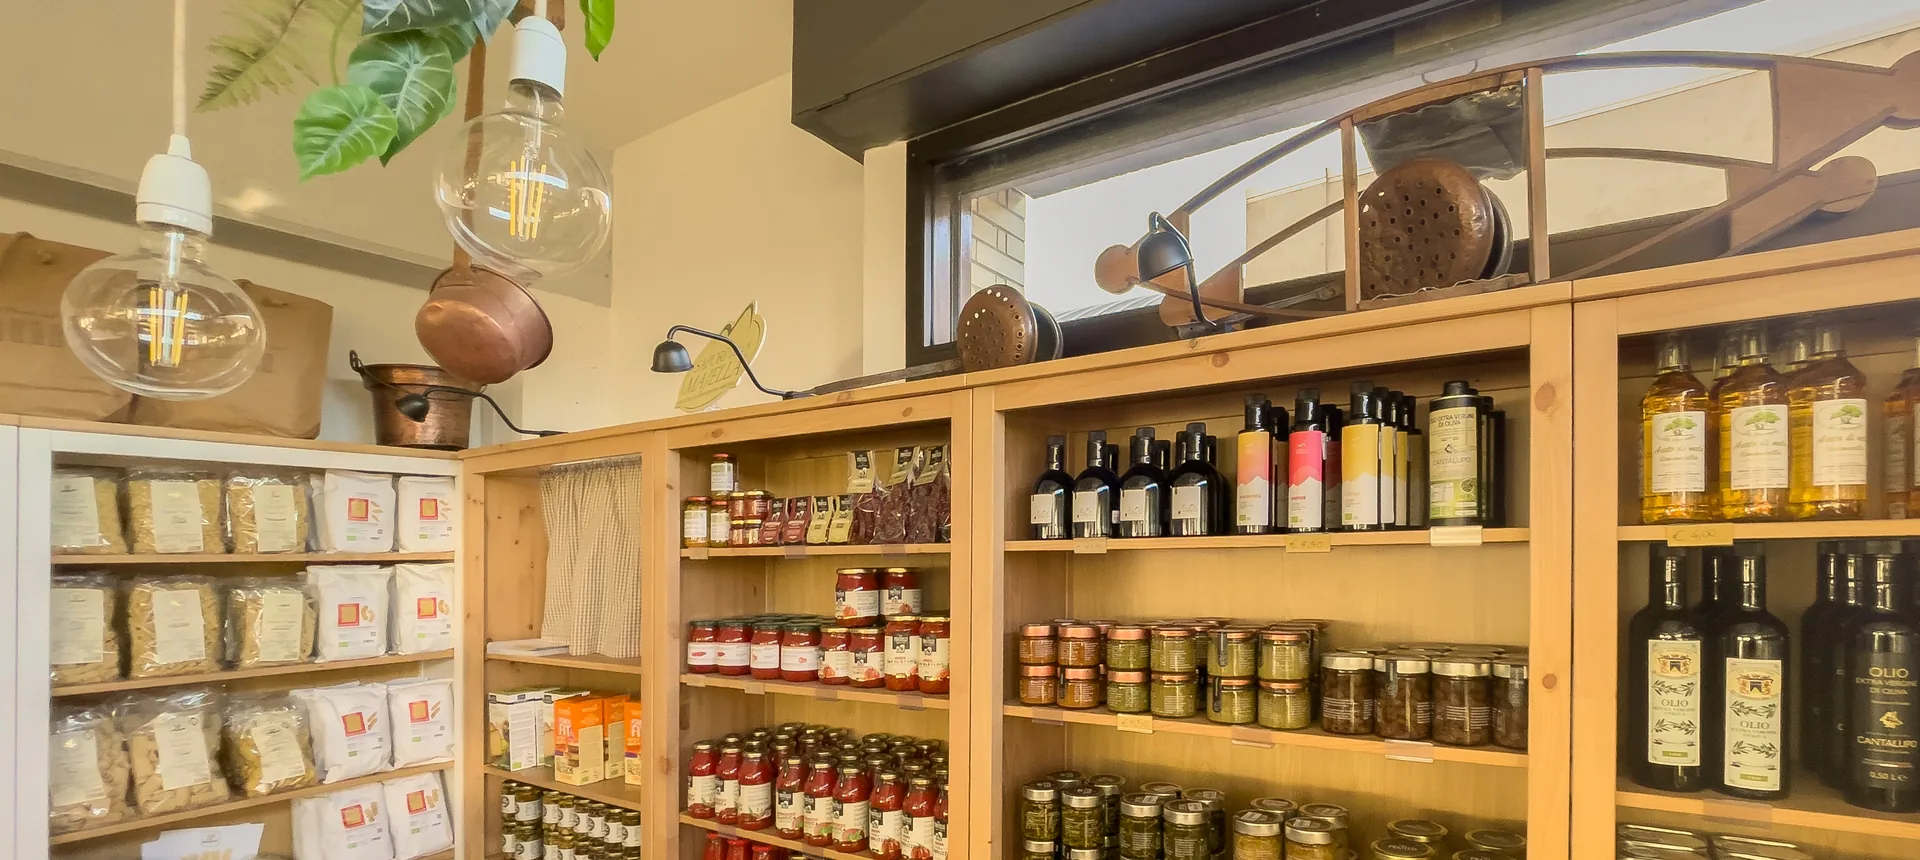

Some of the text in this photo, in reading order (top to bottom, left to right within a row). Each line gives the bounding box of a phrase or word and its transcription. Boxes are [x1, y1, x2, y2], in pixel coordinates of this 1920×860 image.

[1432, 456, 1472, 466] CANTALUPO
[1869, 667, 1909, 678] OLIO
[1855, 677, 1883, 685] EXTRA
[1661, 698, 1689, 707] OLIO
[1740, 720, 1770, 729] OLIO
[1857, 735, 1918, 748] CANTALUPO
